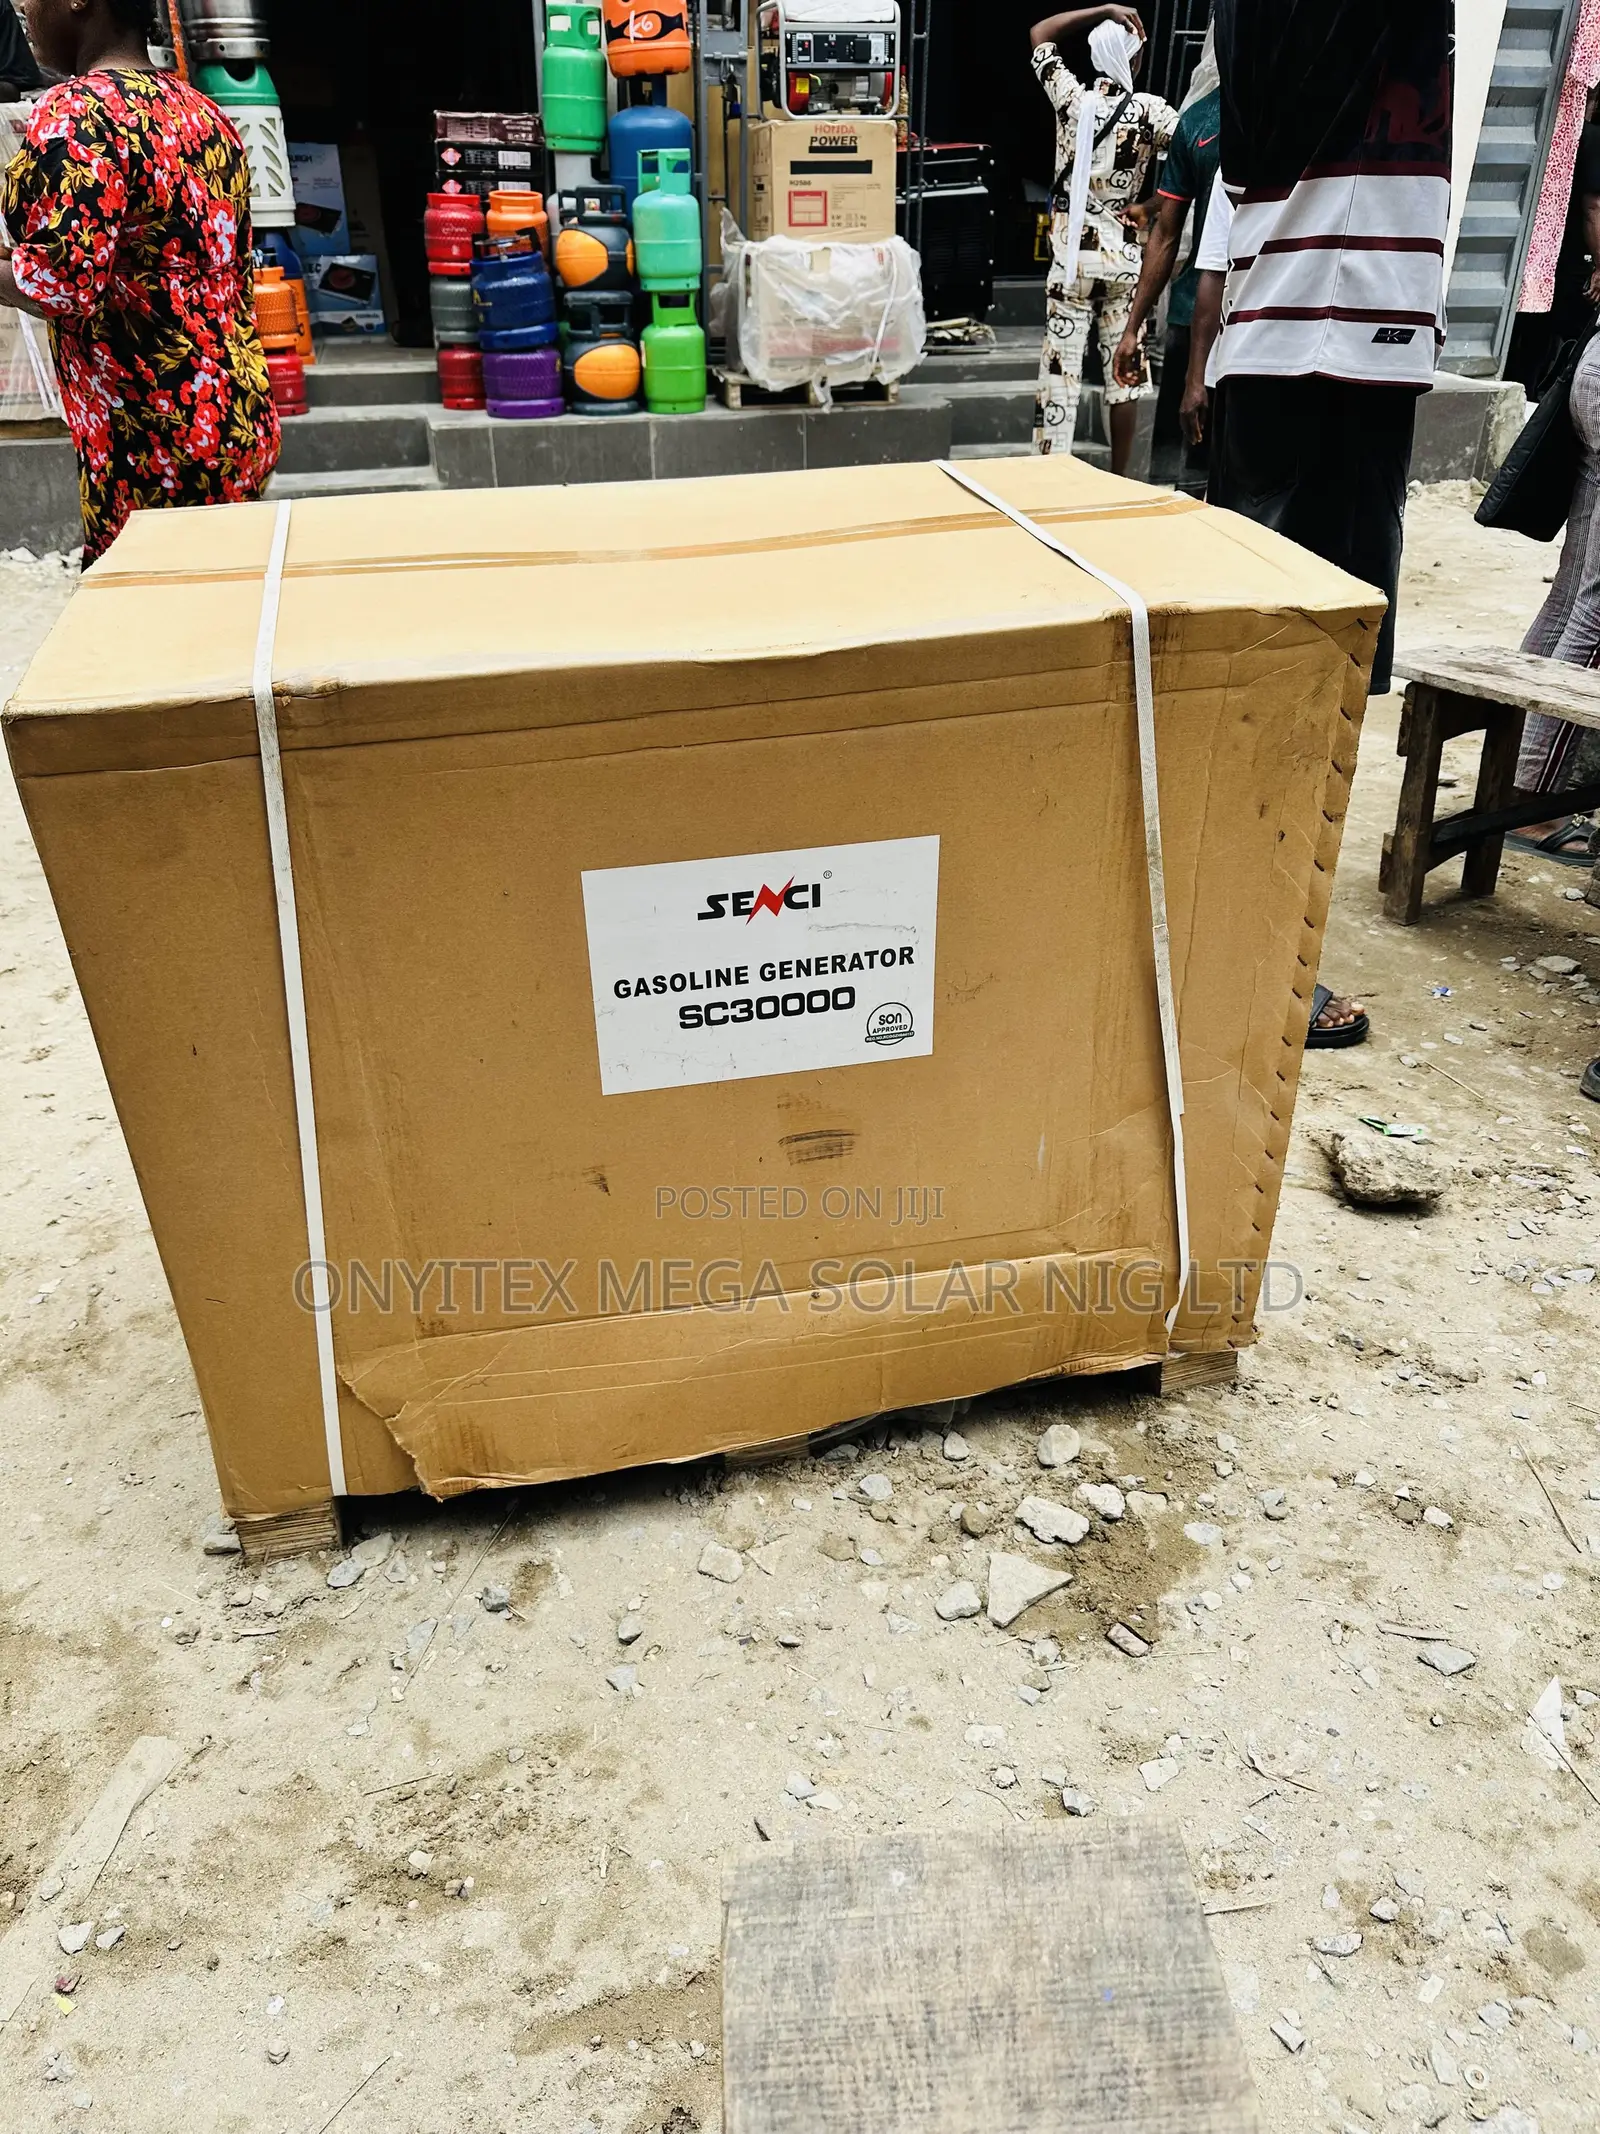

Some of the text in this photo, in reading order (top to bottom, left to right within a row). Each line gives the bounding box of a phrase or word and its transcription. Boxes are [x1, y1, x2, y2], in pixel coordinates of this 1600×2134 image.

[810, 136, 858, 146] POWER
[814, 124, 856, 135] HONDA
[697, 875, 821, 926] SENCI
[613, 946, 914, 999] GASOLINE GENERATOR
[679, 986, 856, 1029] SC30000
[872, 1024, 908, 1034] APPROVED
